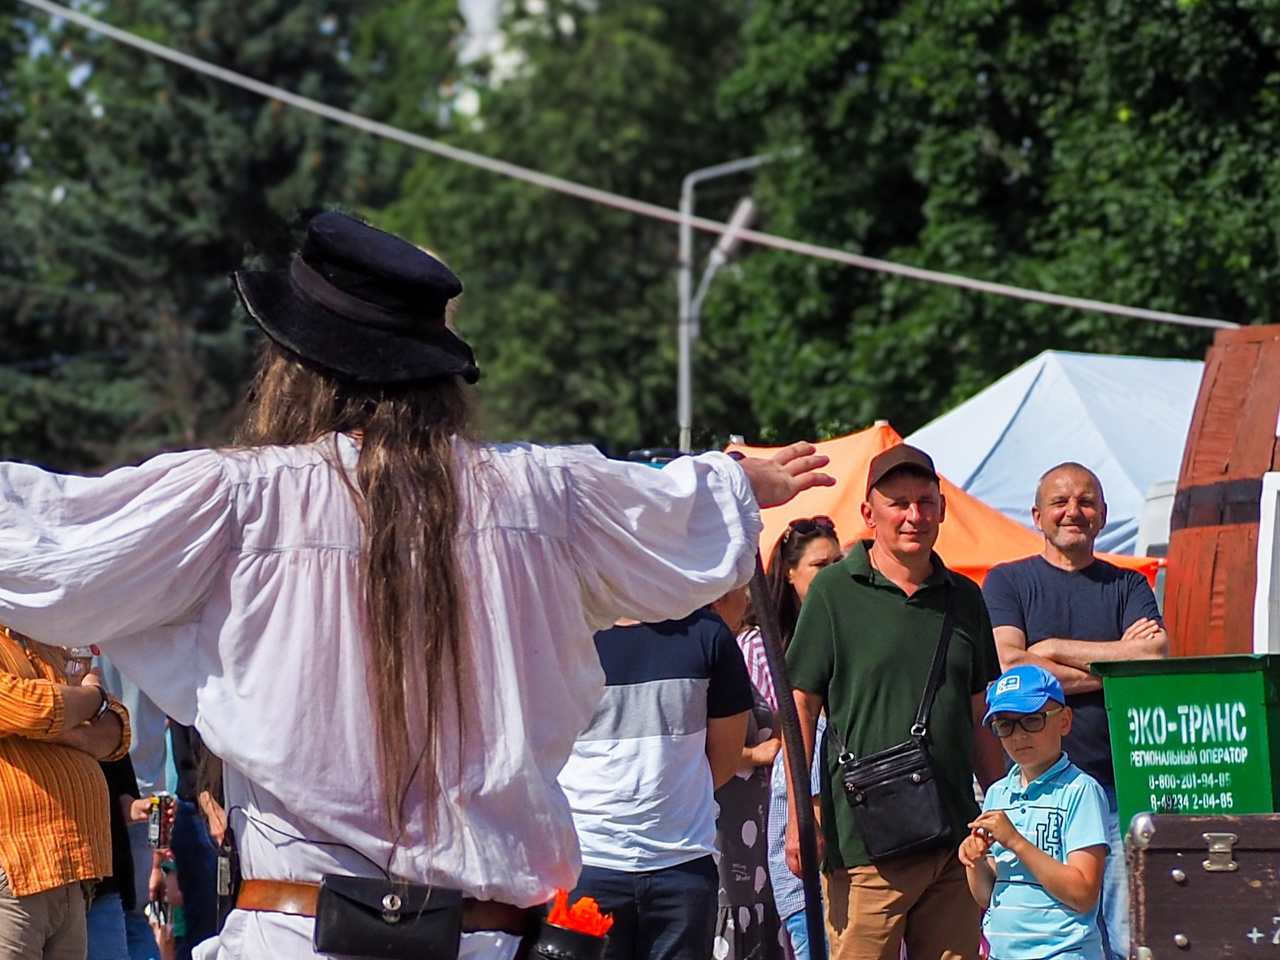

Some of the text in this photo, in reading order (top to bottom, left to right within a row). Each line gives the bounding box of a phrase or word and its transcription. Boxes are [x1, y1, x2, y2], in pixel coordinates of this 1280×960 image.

[1128, 702, 1247, 745] ЭКО-ТРАНС
[1130, 747, 1248, 767] РЕГИОНАЛЬНЫЙ ОПЕРАТОР
